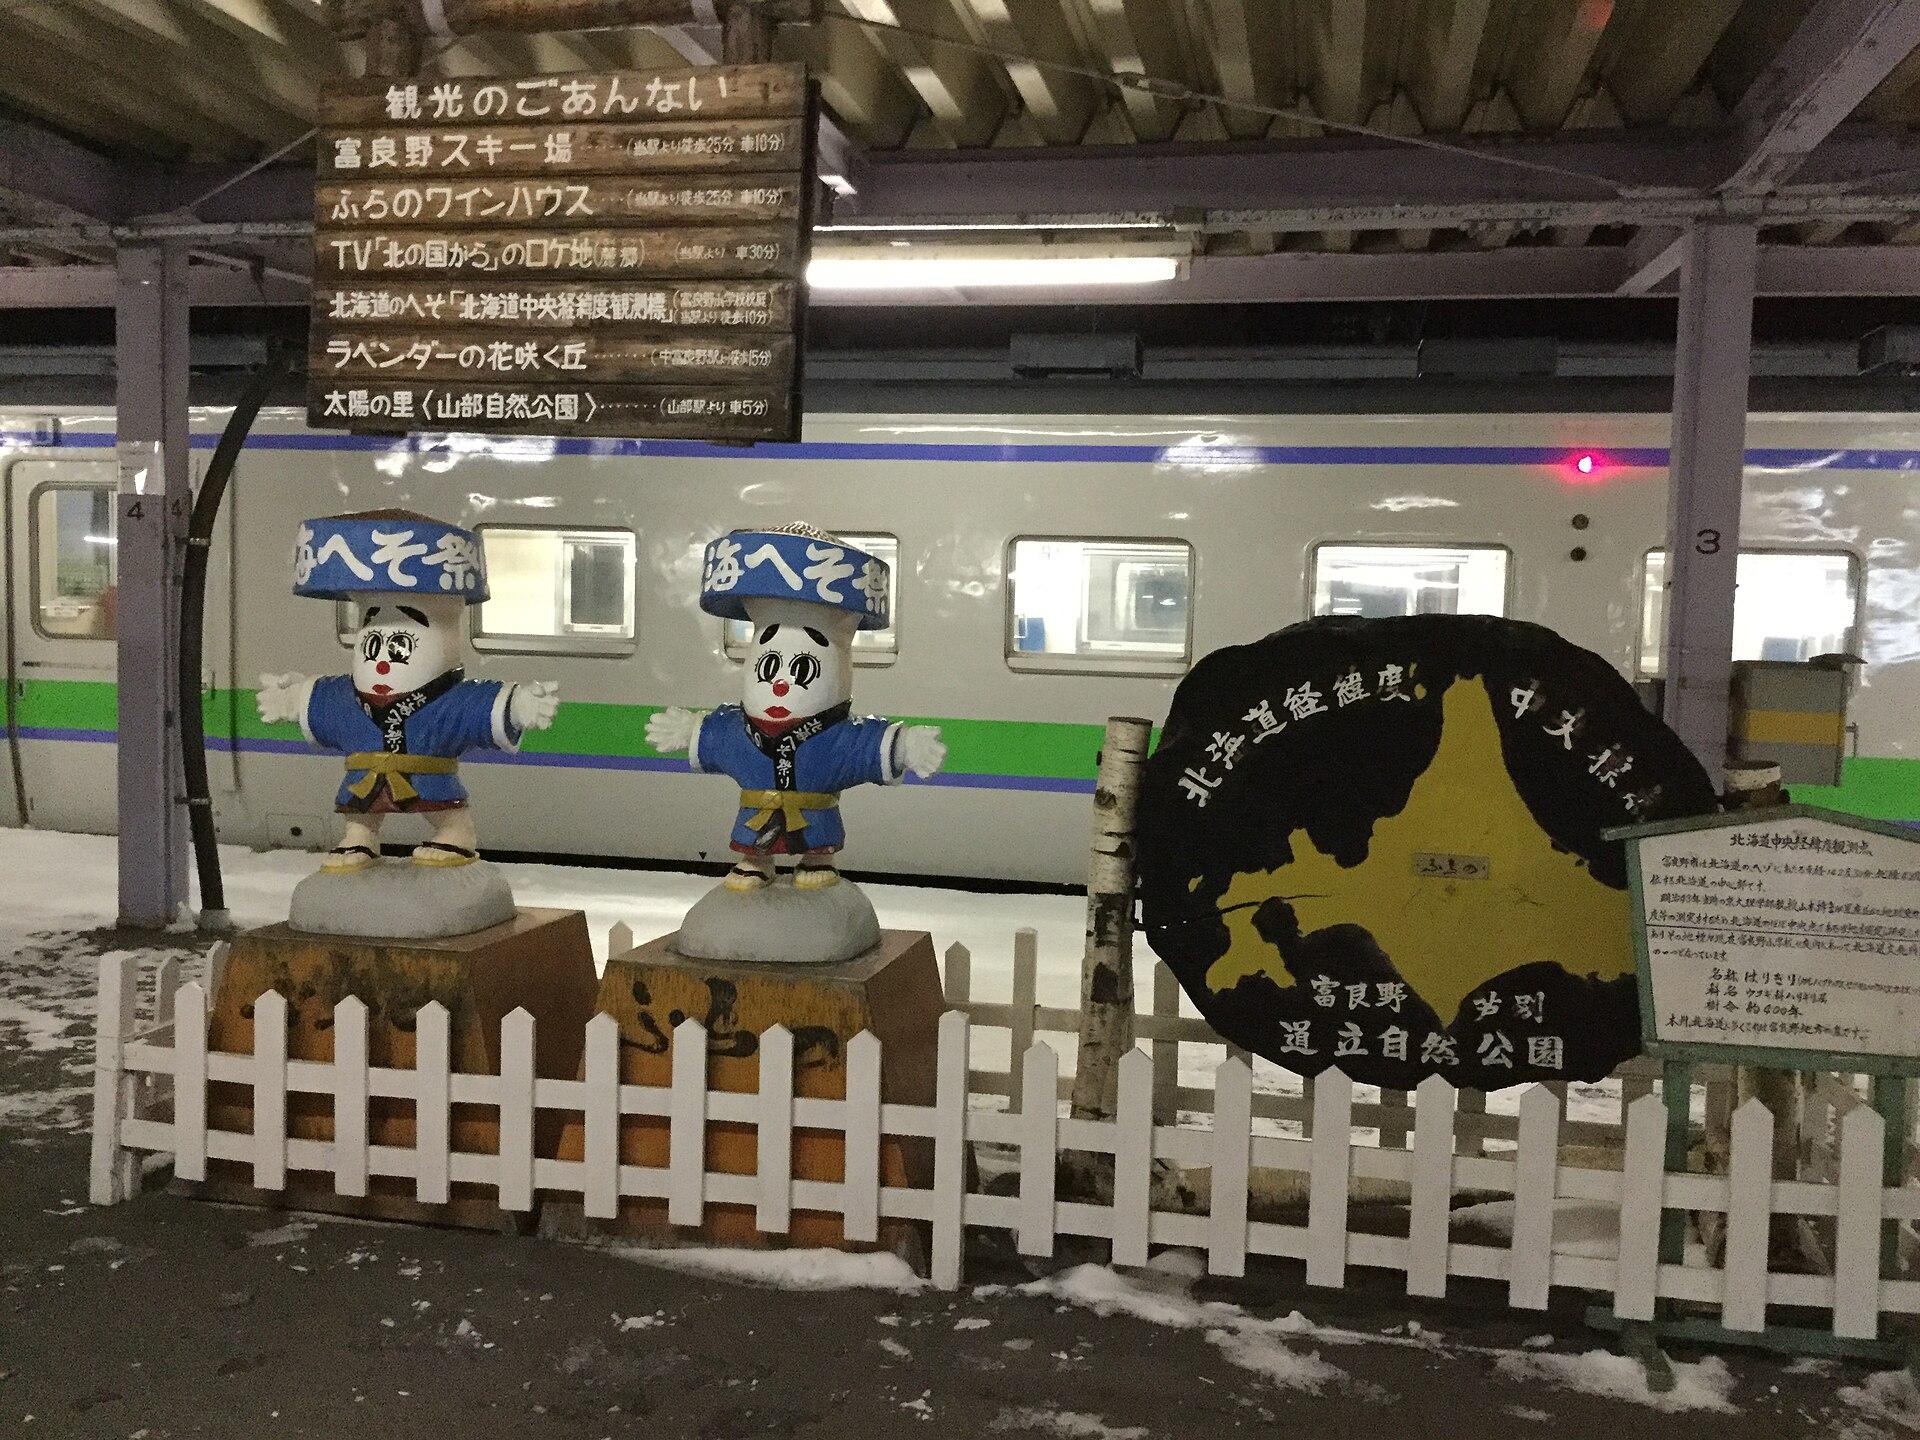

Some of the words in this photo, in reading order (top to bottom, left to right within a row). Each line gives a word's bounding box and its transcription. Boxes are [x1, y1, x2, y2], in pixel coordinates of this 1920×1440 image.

[385, 76, 728, 120] 観光のごあんない
[333, 133, 573, 169] 富良野スキー場
[330, 184, 594, 221] ふらのワインハウス
[326, 340, 588, 372] ラベンダーの花咲く丘
[126, 501, 145, 520] 4
[1695, 528, 1721, 554] 3
[1310, 974, 1408, 1013] 富良野
[1279, 1020, 1565, 1070] 道立自然公園
